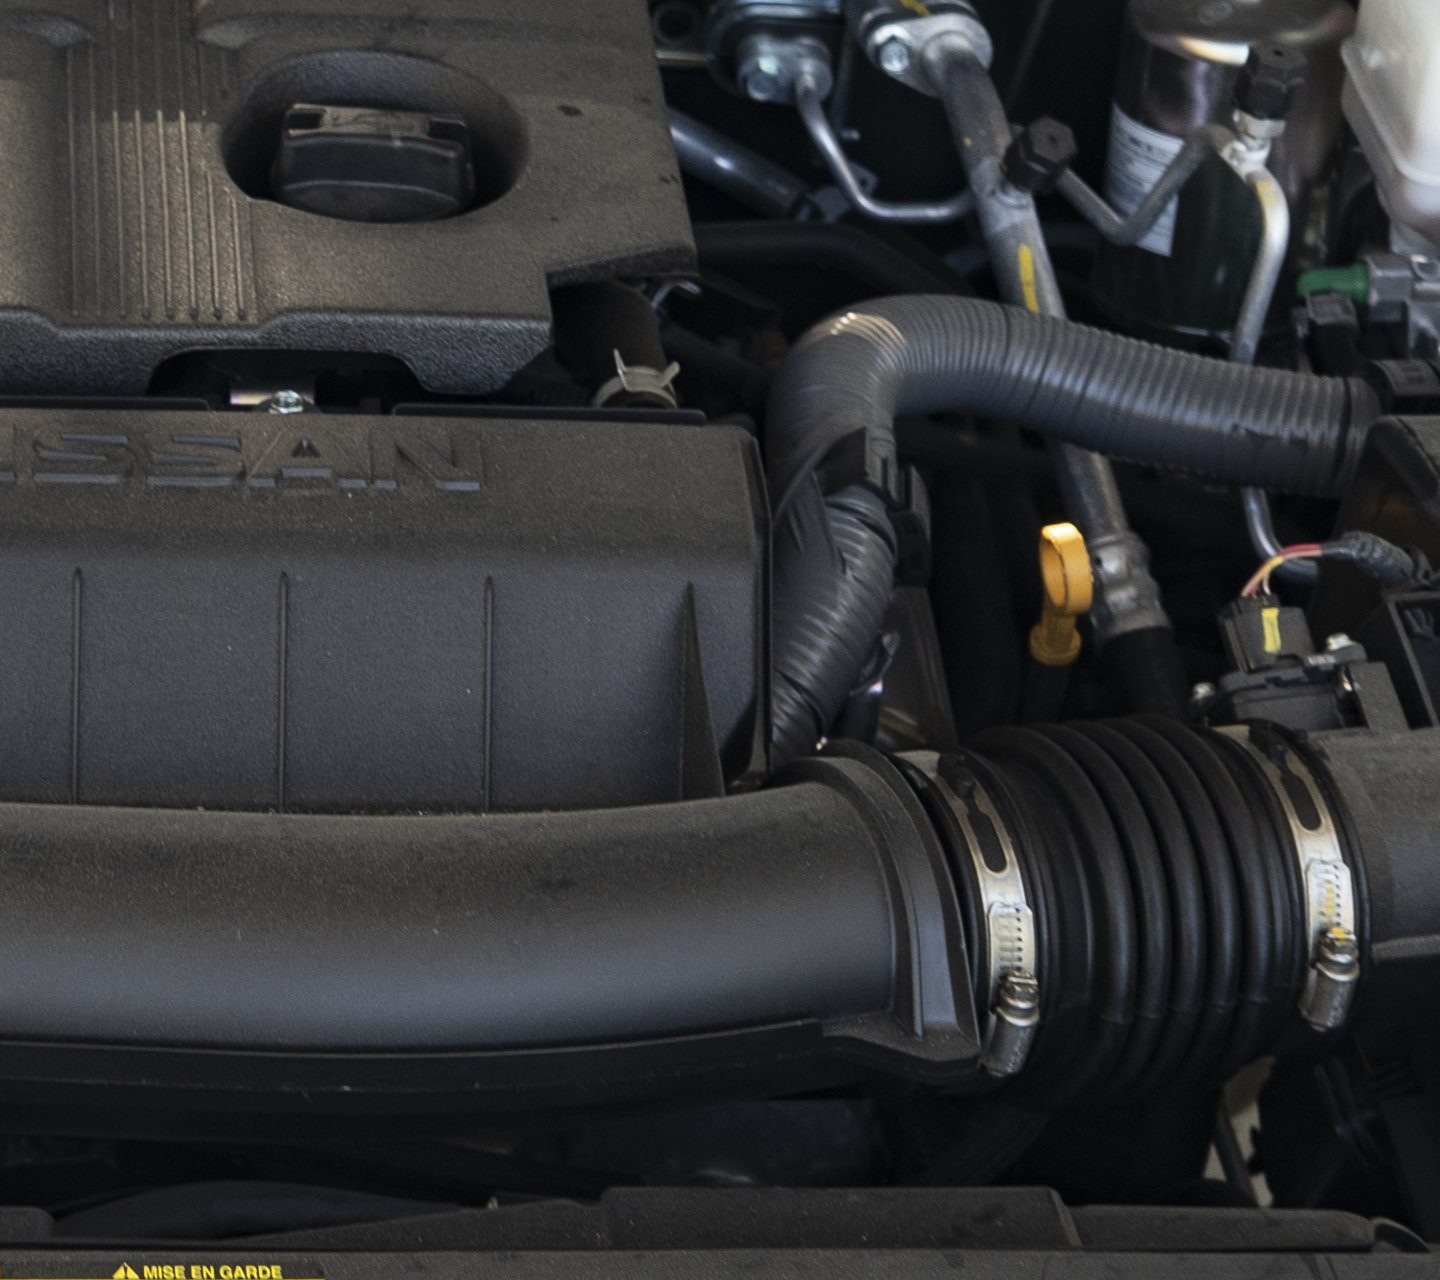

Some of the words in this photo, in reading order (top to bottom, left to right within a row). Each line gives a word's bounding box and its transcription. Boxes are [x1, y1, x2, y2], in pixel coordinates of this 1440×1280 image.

[143, 1265, 185, 1279] MISE
[191, 1265, 215, 1279] EN
[220, 1265, 283, 1279] GARDE
